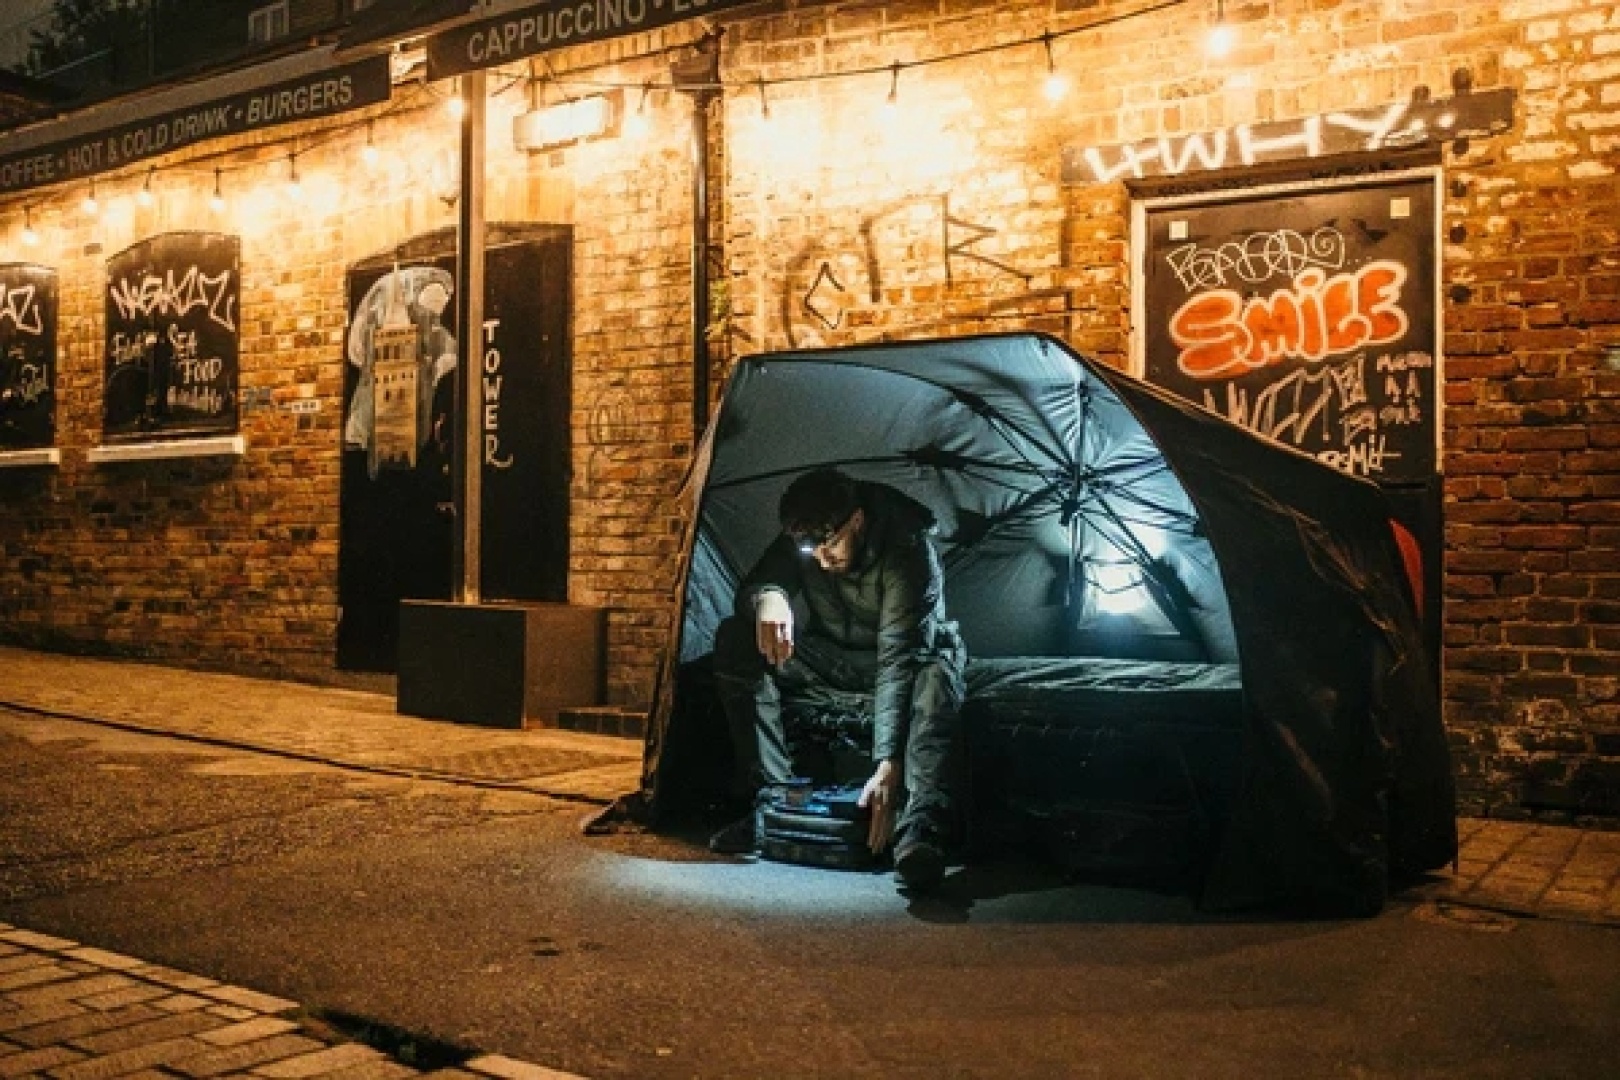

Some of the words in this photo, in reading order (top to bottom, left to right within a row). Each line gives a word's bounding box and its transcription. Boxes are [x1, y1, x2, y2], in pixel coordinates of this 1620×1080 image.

[467, 0, 646, 62] CAPPUCCINO
[68, 140, 103, 173] HOT
[121, 123, 169, 158] COLD
[172, 104, 231, 144] DRINK
[247, 75, 352, 125] BURGERS
[482, 318, 514, 469] TOWER
